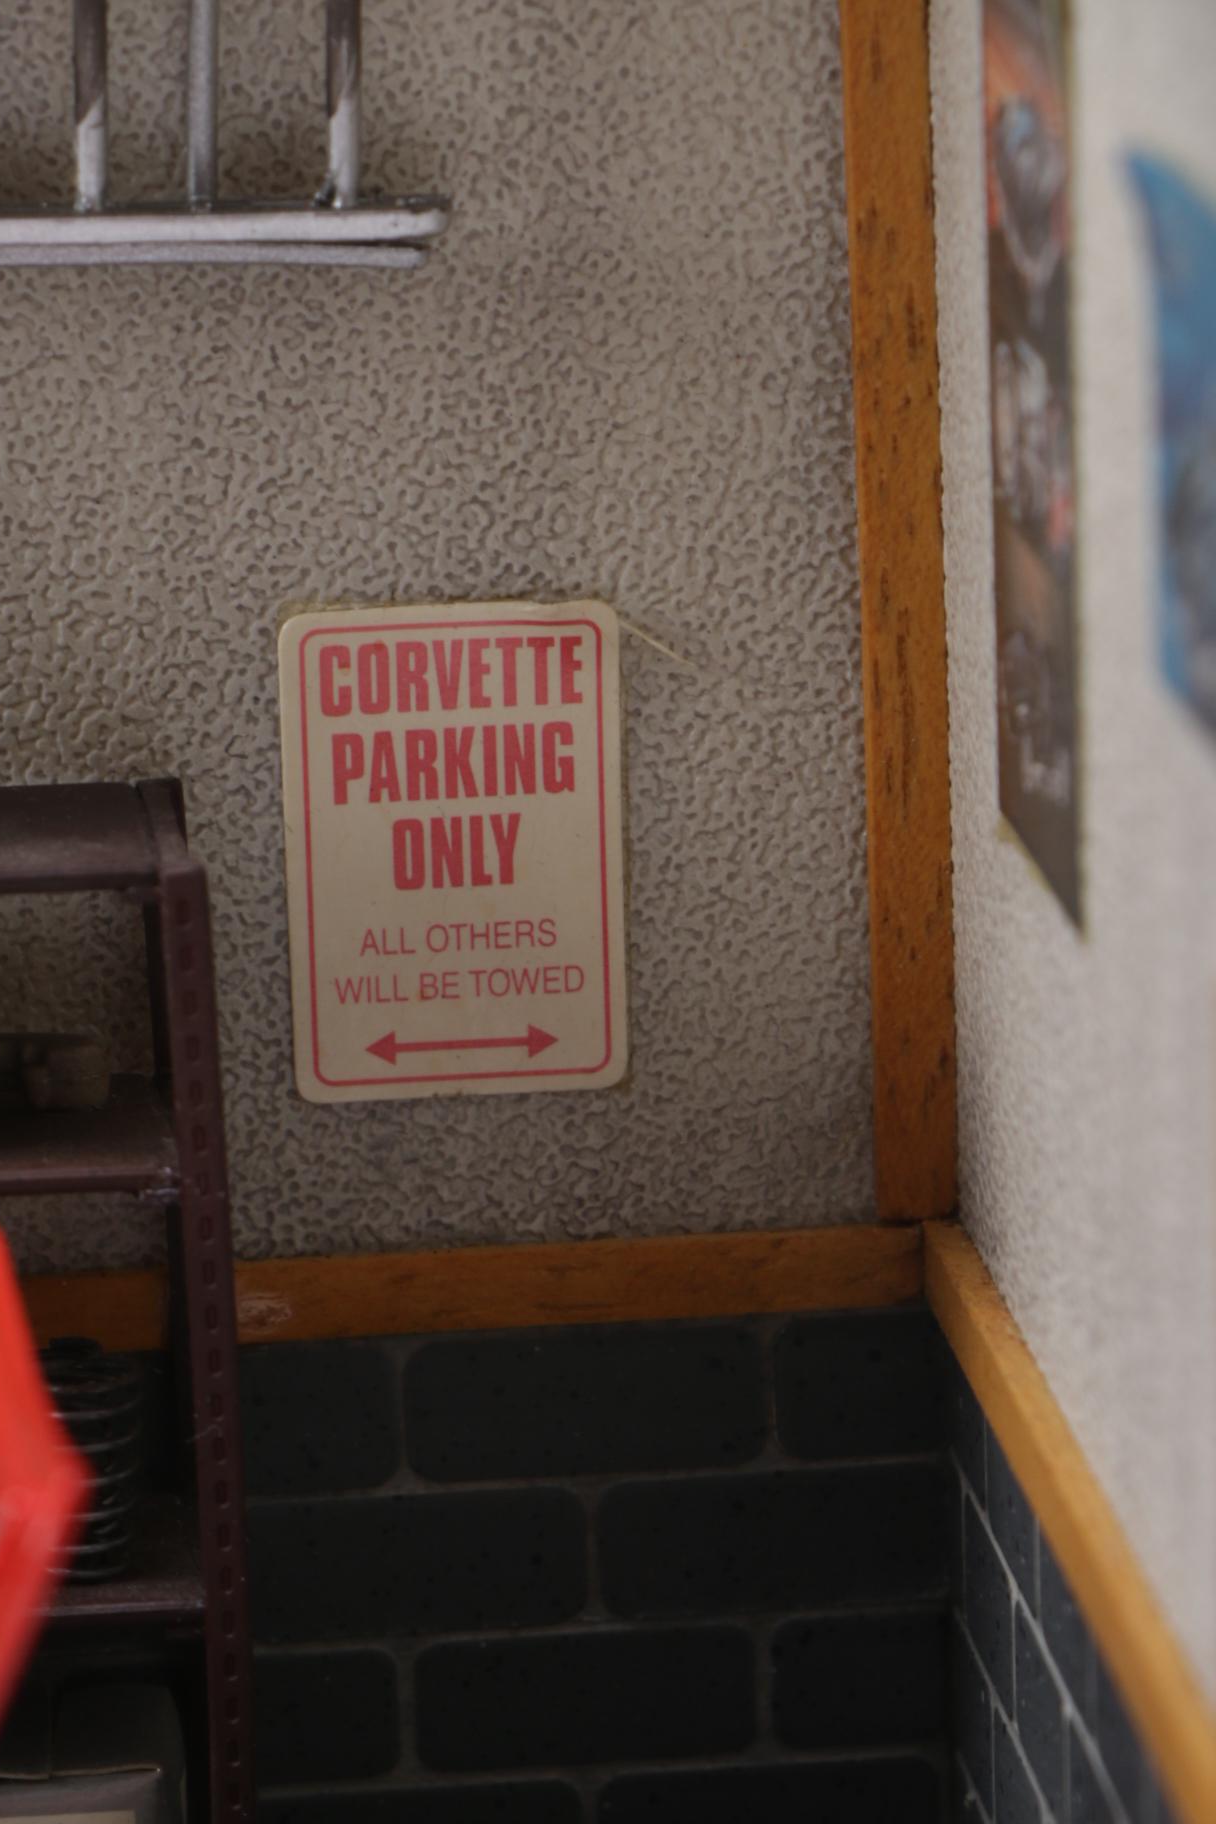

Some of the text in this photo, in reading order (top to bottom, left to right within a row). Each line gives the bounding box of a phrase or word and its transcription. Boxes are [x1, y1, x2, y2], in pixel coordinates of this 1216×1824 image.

[319, 635, 583, 718] CORVETTE
[331, 721, 575, 805] PARKING
[392, 812, 522, 891] ONLY
[359, 918, 558, 957] ALL OTHERS
[335, 964, 585, 1005] WILL BE TOWED
